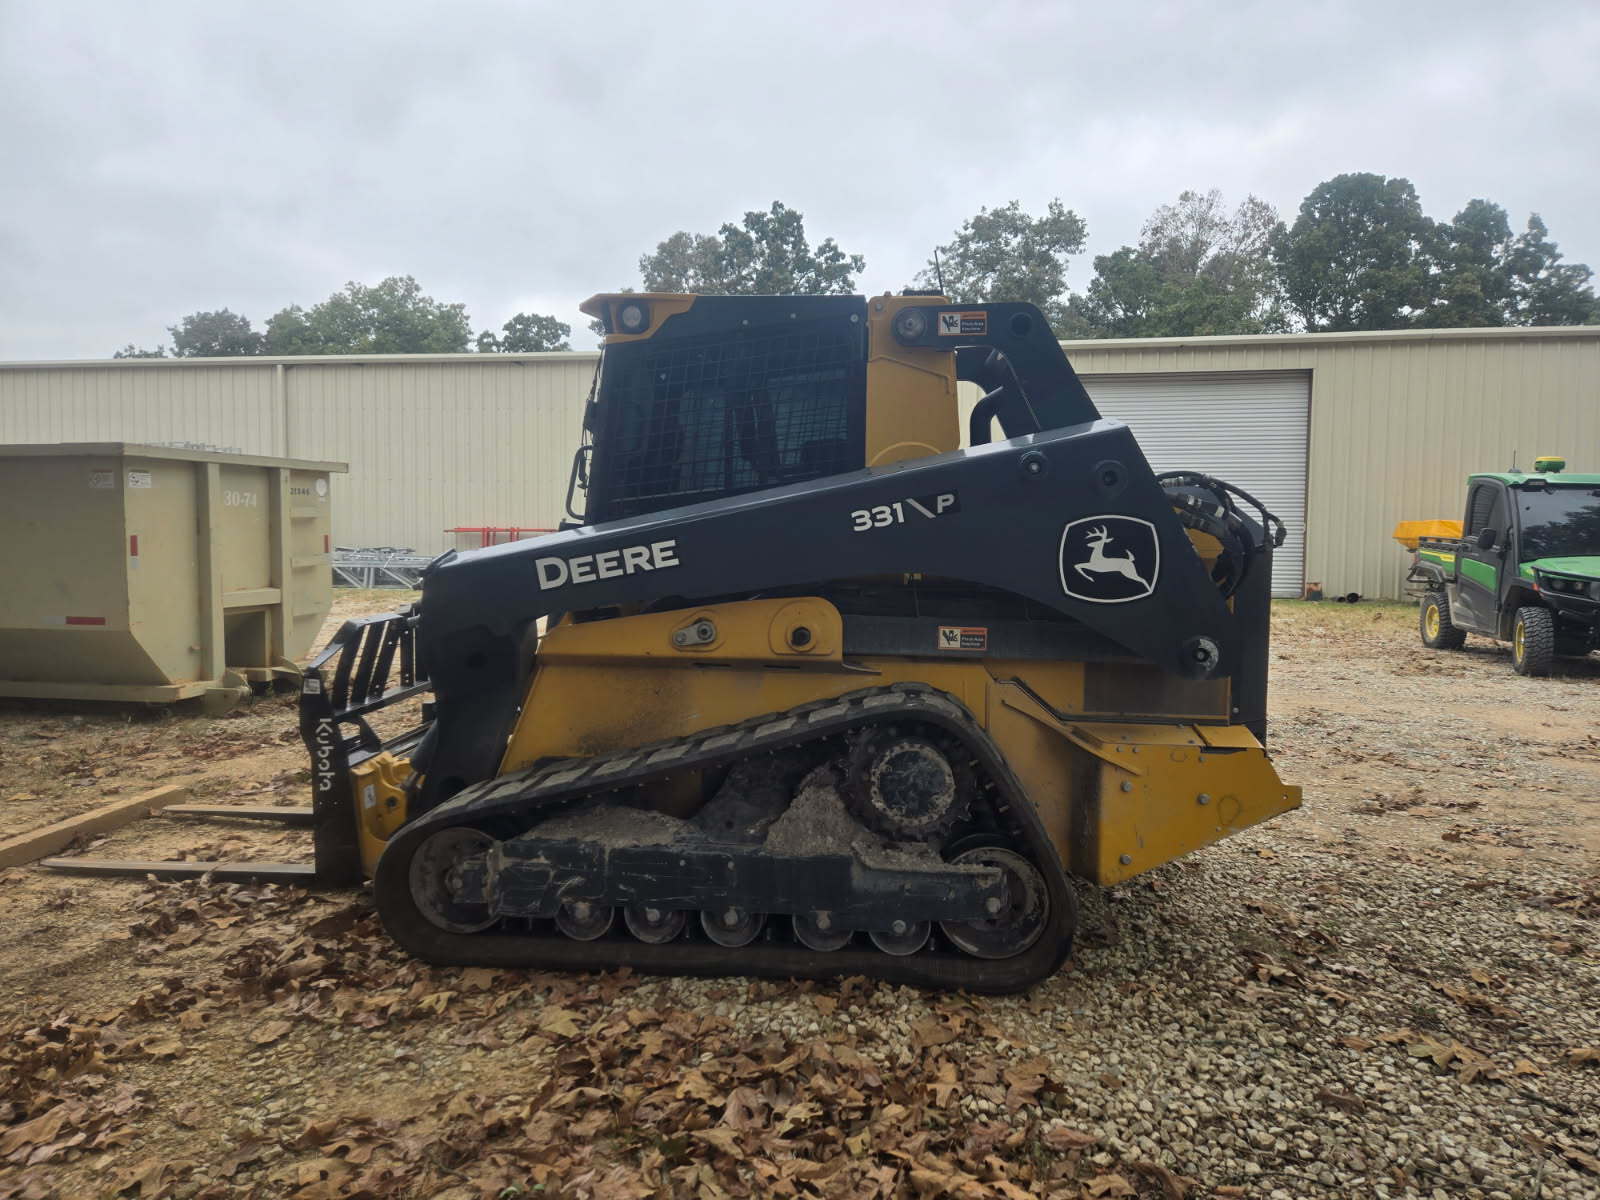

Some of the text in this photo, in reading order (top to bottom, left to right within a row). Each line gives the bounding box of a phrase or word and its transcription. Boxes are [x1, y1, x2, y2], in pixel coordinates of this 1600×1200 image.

[851, 502, 905, 532] 331
[535, 539, 680, 590] DEERE
[315, 718, 336, 792] Kubota
